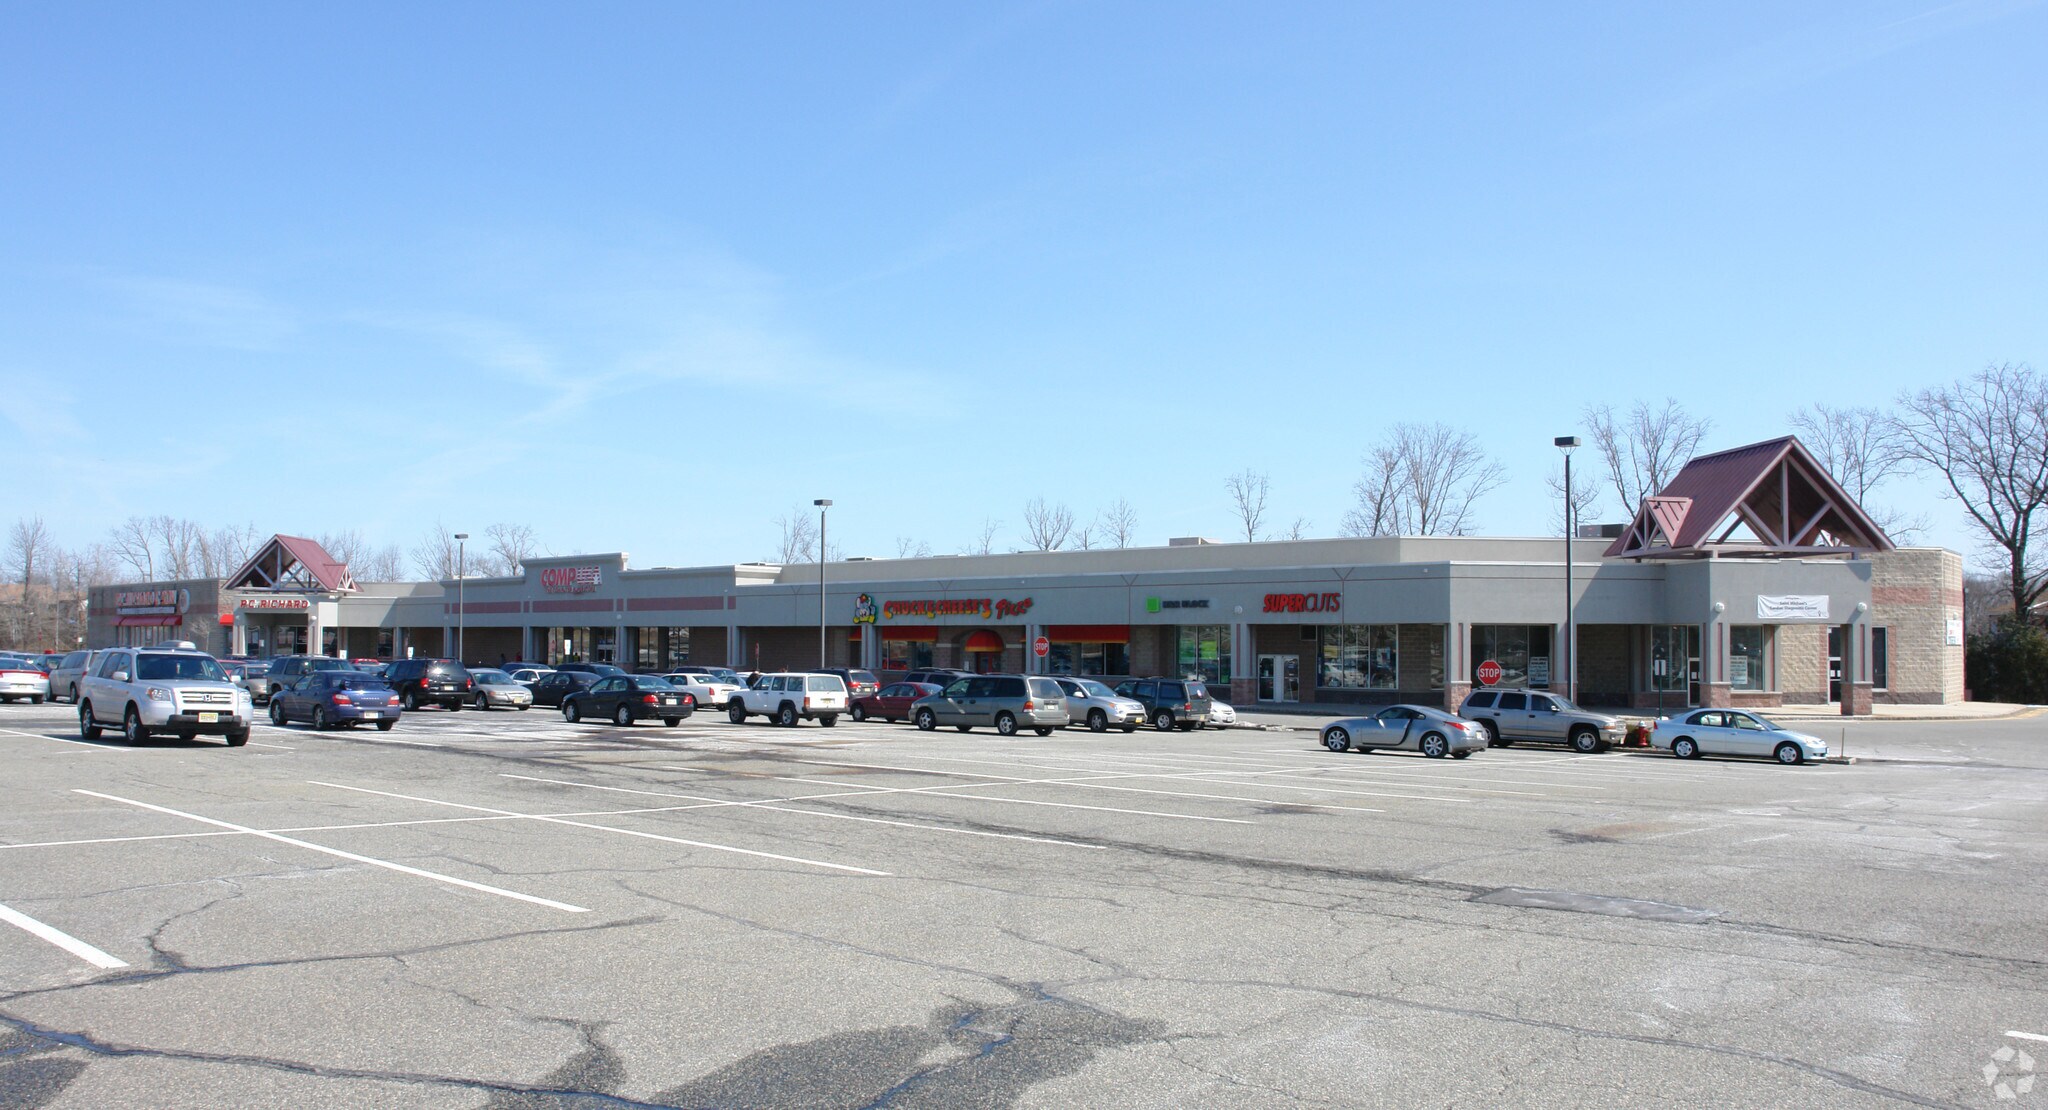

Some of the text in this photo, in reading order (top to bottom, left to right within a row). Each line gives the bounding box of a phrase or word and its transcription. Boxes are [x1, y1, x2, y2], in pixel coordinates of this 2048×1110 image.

[260, 599, 309, 609] RICHARD
[1263, 592, 1341, 613] SUPERCUTS
[1034, 642, 1048, 651] STOP
[1480, 668, 1500, 678] STOP
